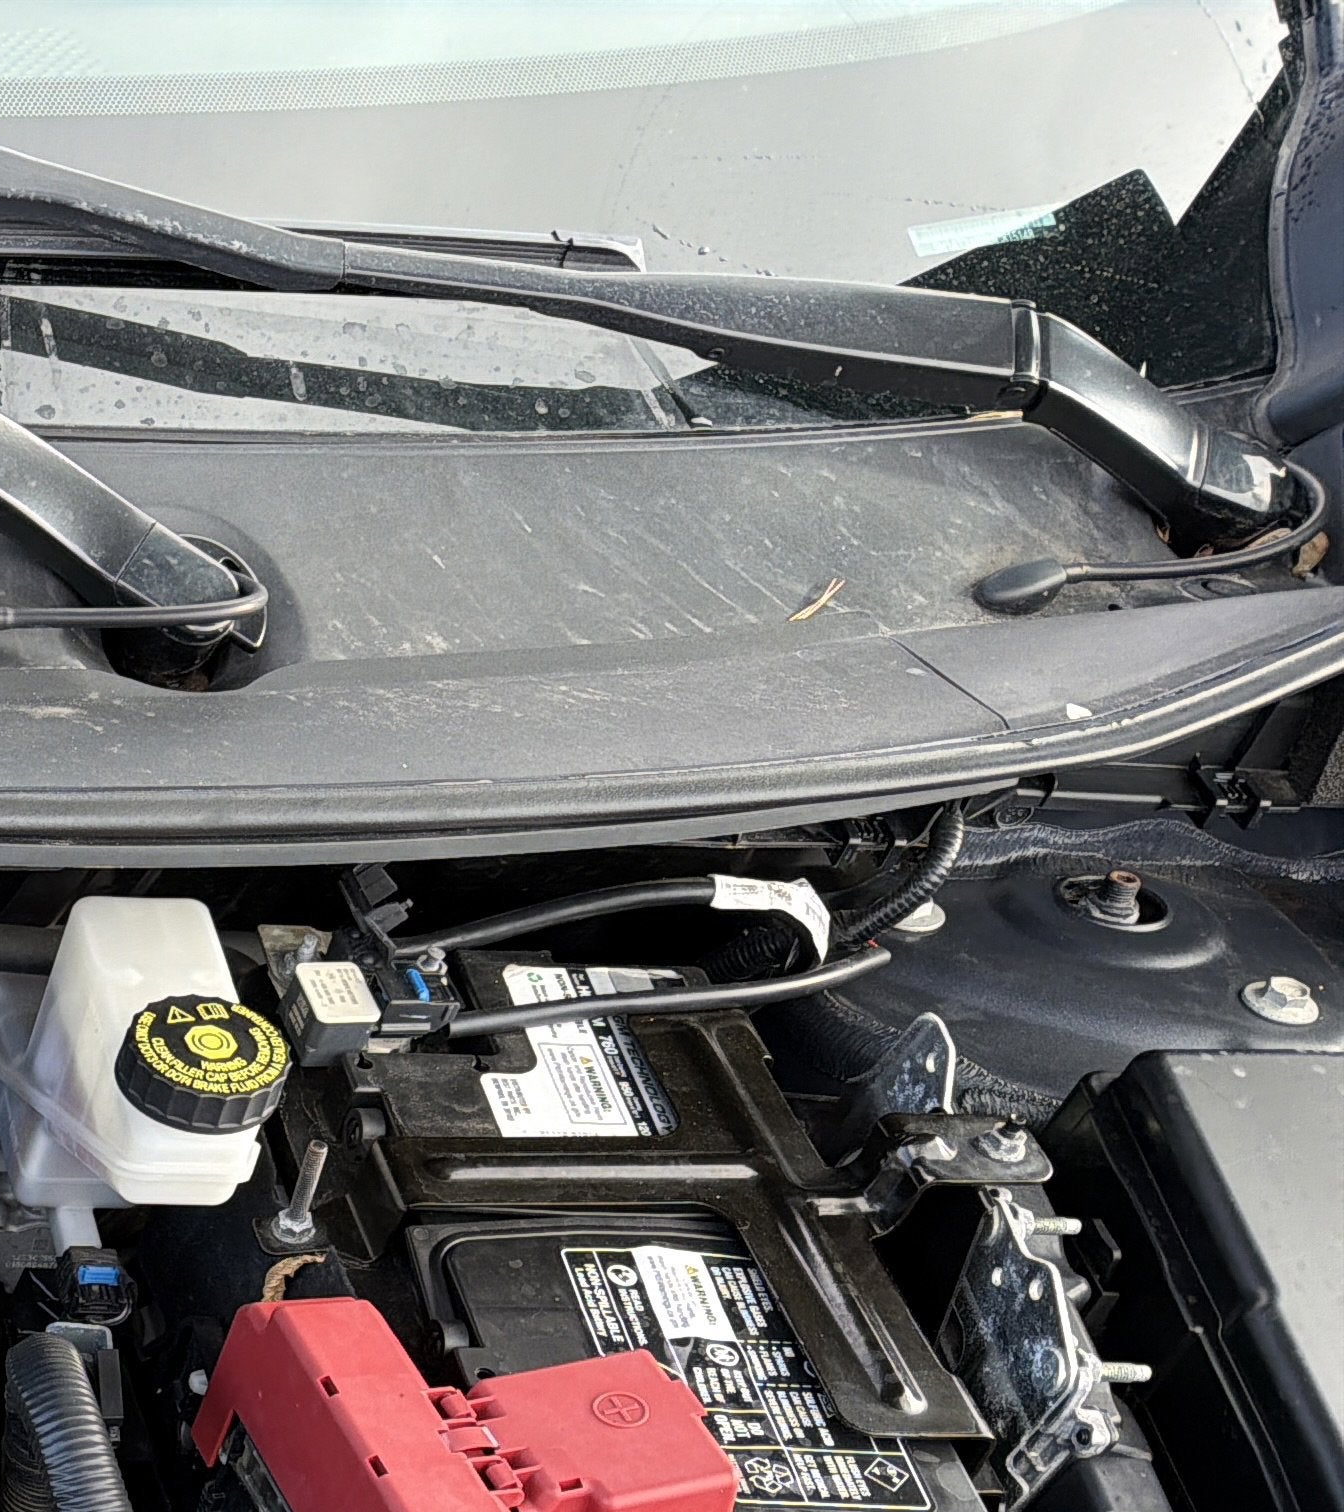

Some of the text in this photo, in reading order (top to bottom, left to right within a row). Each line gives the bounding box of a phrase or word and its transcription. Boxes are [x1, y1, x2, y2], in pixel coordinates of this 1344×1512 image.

[603, 1035, 619, 1055] 760
[152, 1038, 175, 1063] CLEAN
[169, 1059, 204, 1079] FILLER
[206, 1072, 227, 1082] CAP
[228, 1061, 265, 1081] BEFORE
[201, 1057, 247, 1071] WARNING
[153, 1060, 169, 1073] OR
[193, 1080, 230, 1094] BRAKE
[230, 1080, 259, 1092] FLUID
[255, 1067, 280, 1086] FROM
[621, 1041, 674, 1133] TECHNOLOGY
[582, 1263, 625, 1343] NON-SPILLABLE
[626, 1288, 646, 1312] READ
[728, 1418, 752, 1438] NOT
